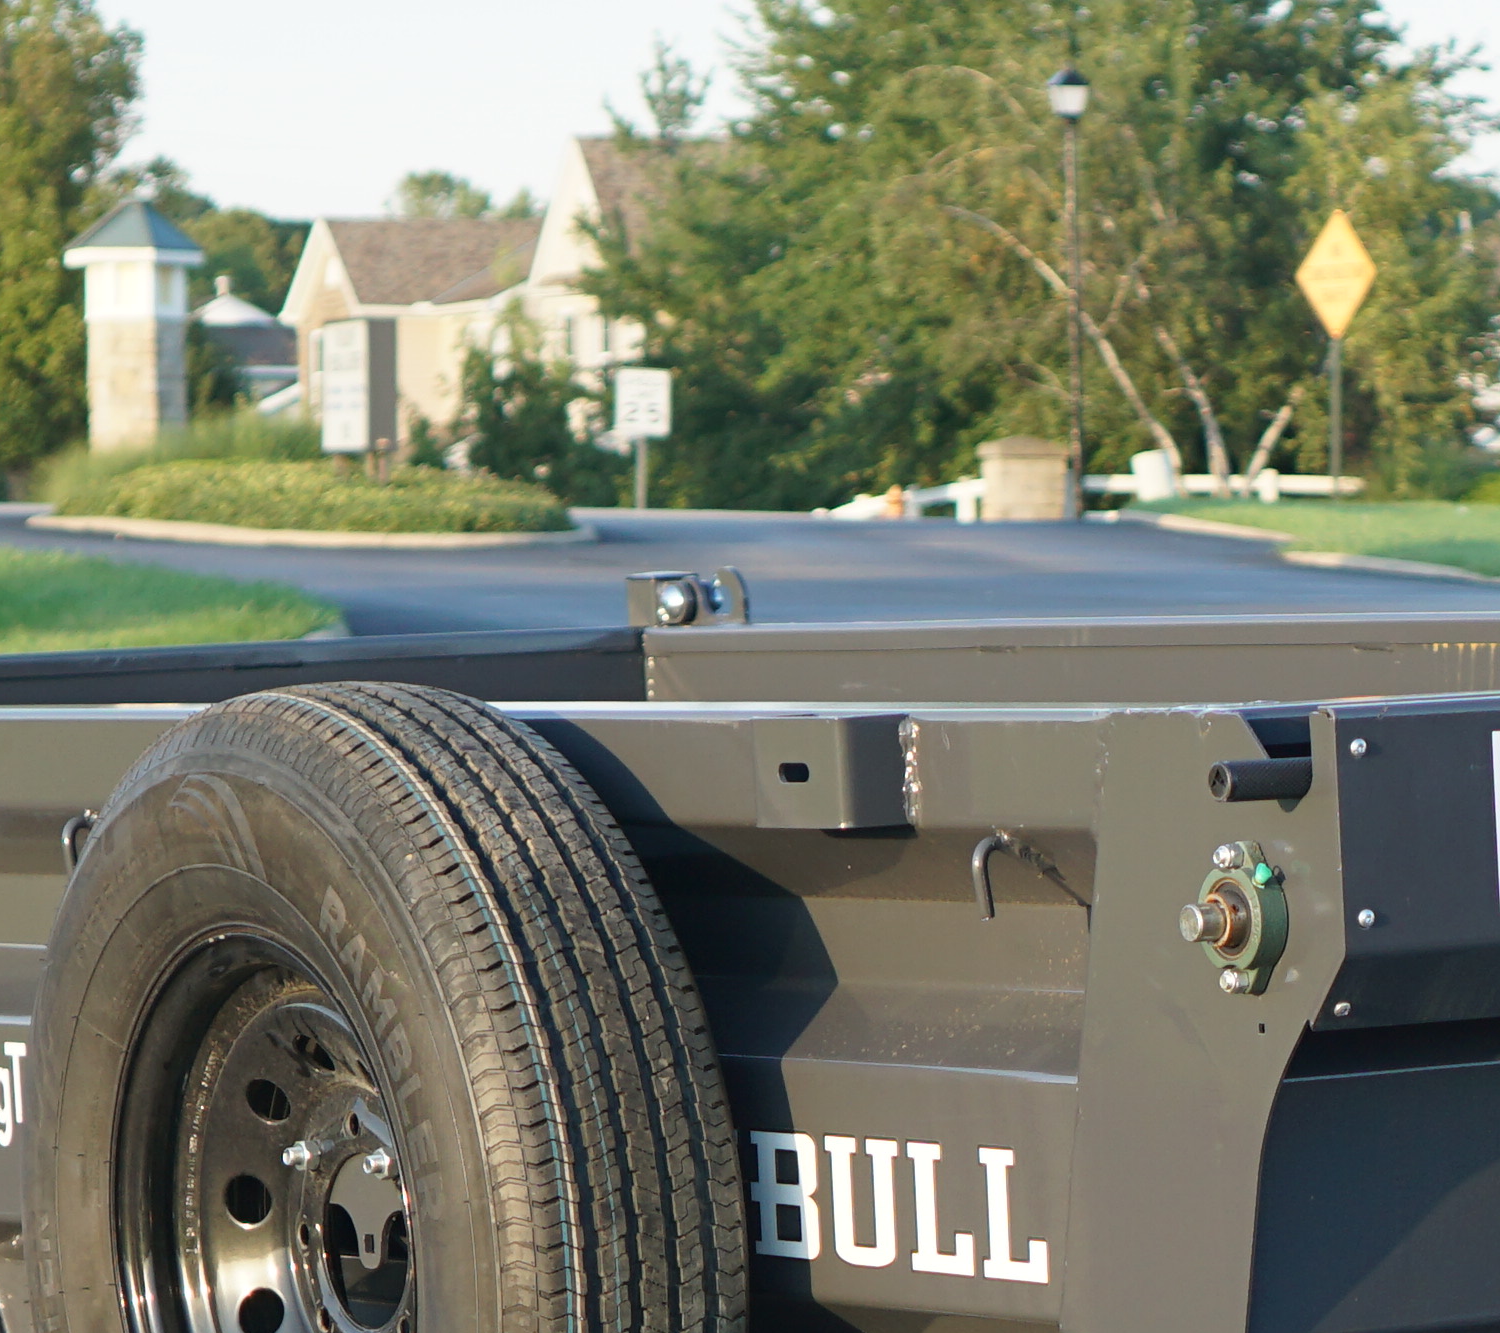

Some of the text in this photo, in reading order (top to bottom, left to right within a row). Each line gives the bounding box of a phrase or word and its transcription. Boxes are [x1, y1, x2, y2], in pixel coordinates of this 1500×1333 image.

[623, 400, 662, 423] 25
[319, 884, 444, 1222] RAMBLER
[748, 1130, 1049, 1285] BULL
